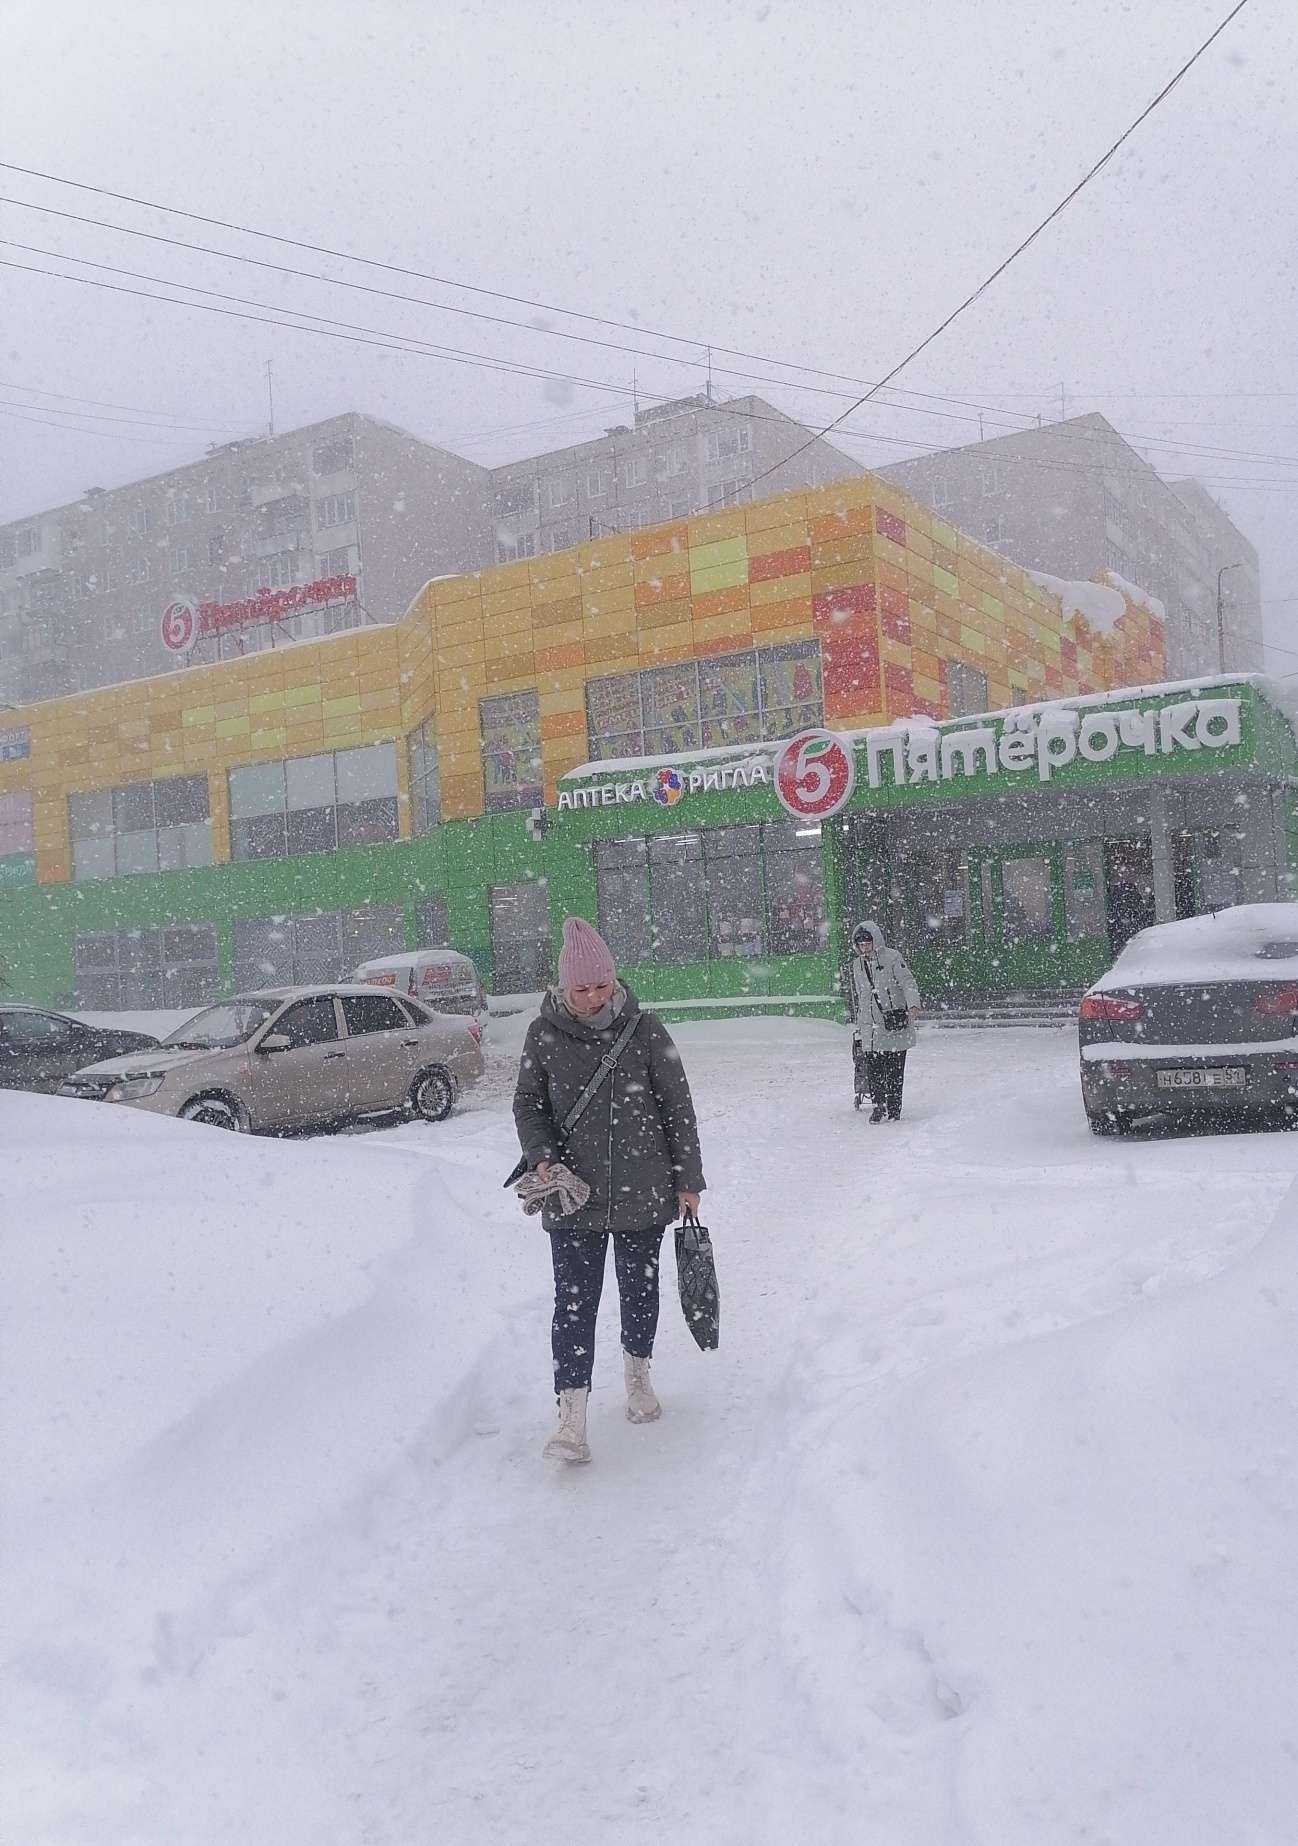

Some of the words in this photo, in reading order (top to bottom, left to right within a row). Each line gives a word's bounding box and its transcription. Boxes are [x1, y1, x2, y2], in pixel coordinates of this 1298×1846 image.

[866, 699, 1242, 782] Пятёрочка
[557, 779, 647, 811] АПТЕКА
[688, 764, 768, 794] РИГЛА
